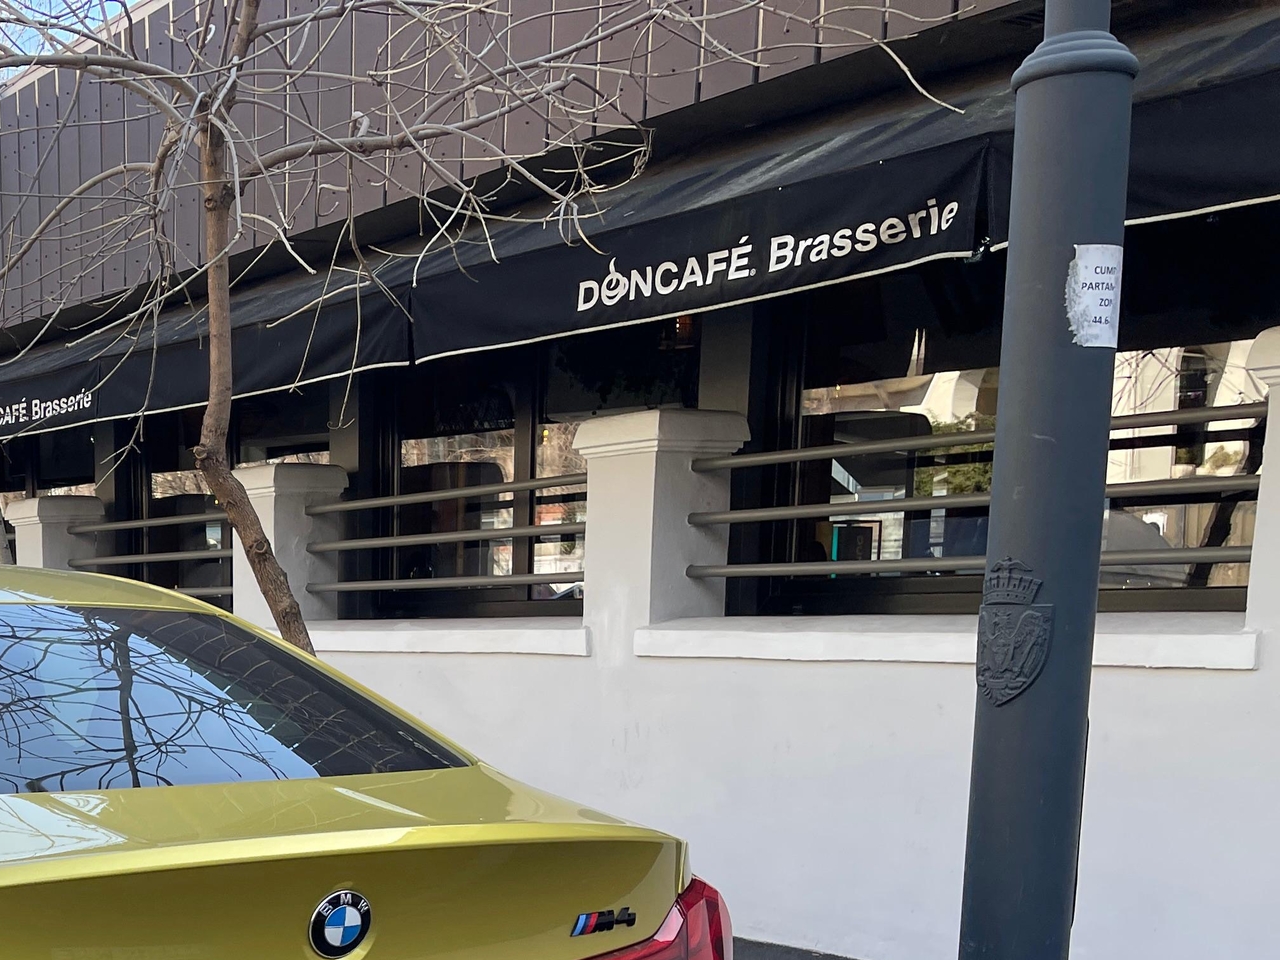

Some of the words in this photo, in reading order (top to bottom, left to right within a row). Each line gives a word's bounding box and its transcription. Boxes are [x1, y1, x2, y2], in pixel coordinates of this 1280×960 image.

[577, 234, 753, 312] DONCAFÉ
[768, 198, 960, 274] Brasserie
[31, 388, 92, 421] Brasserie
[320, 893, 369, 916] BMW
[578, 907, 637, 935] M4
